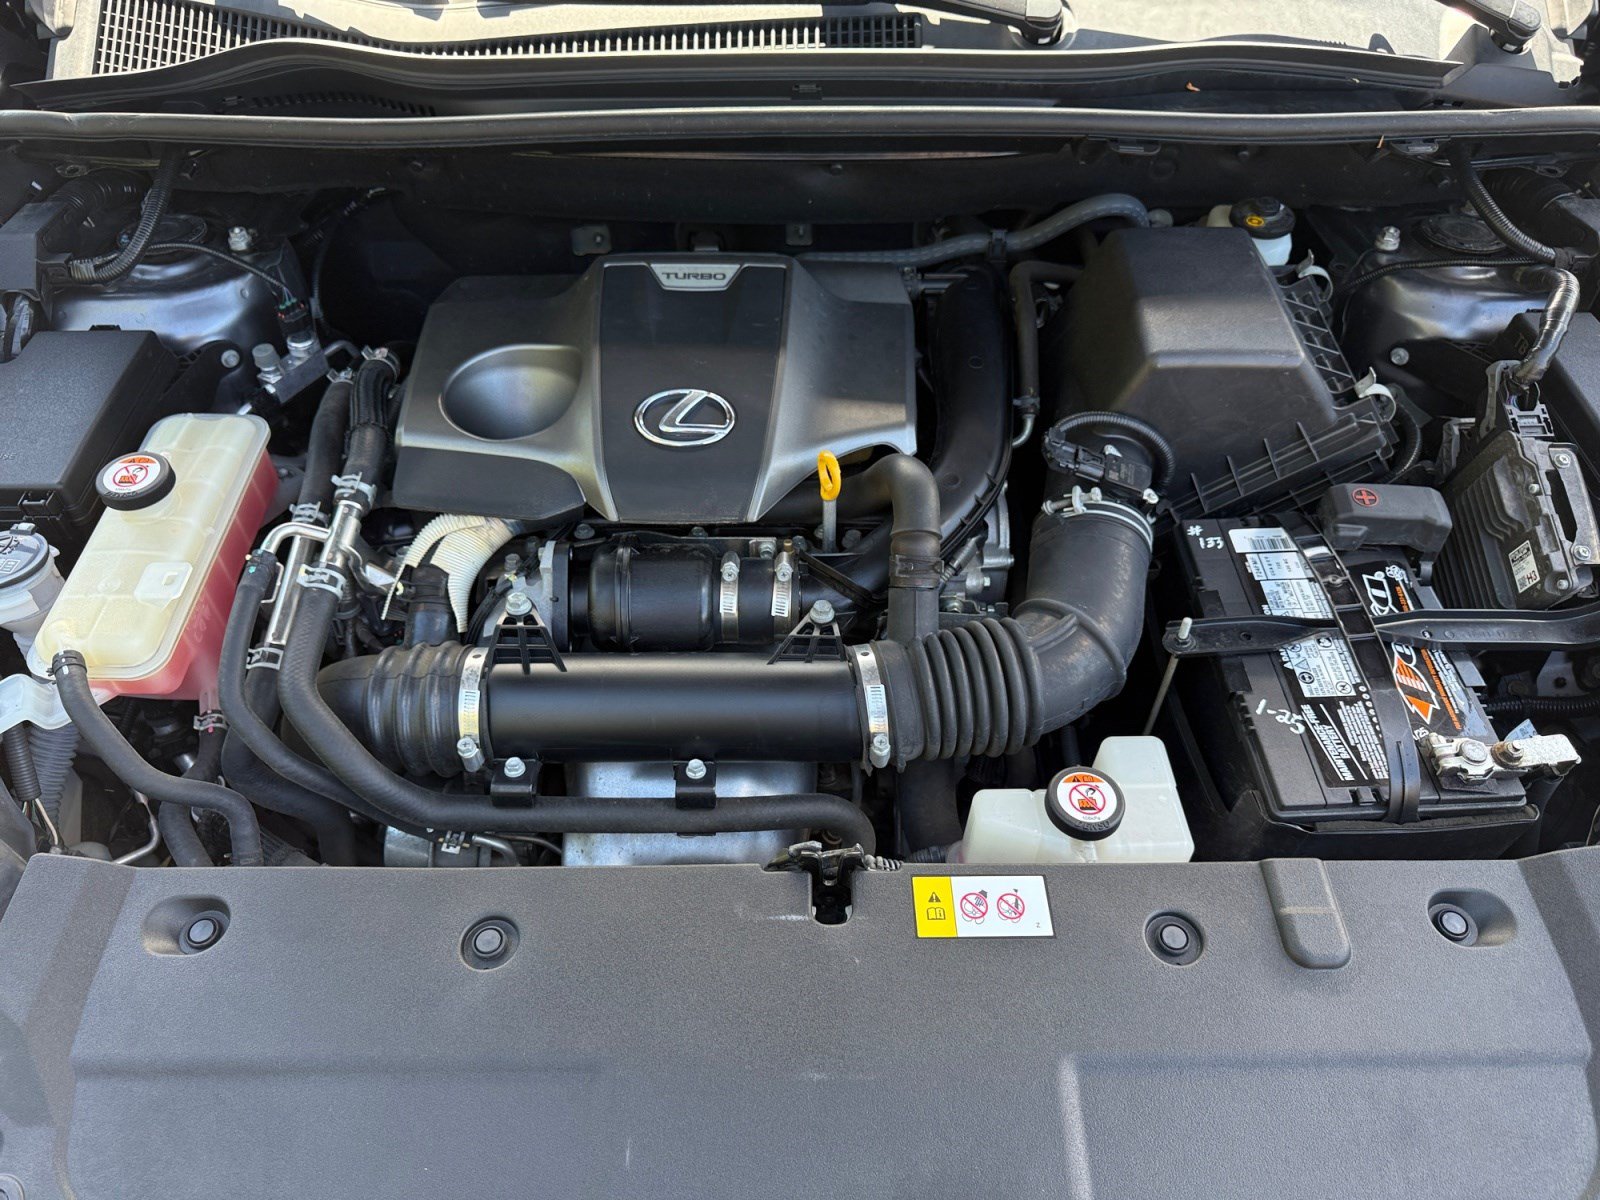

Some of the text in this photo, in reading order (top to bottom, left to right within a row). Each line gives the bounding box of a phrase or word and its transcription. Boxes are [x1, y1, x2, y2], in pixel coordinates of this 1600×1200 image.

[661, 272, 727, 281] TURBO
[1526, 570, 1538, 584] H3
[1255, 698, 1306, 734] 1-25
[1301, 704, 1355, 781] MAINTENANCE-FREE
[1322, 724, 1351, 759] BATTERY
